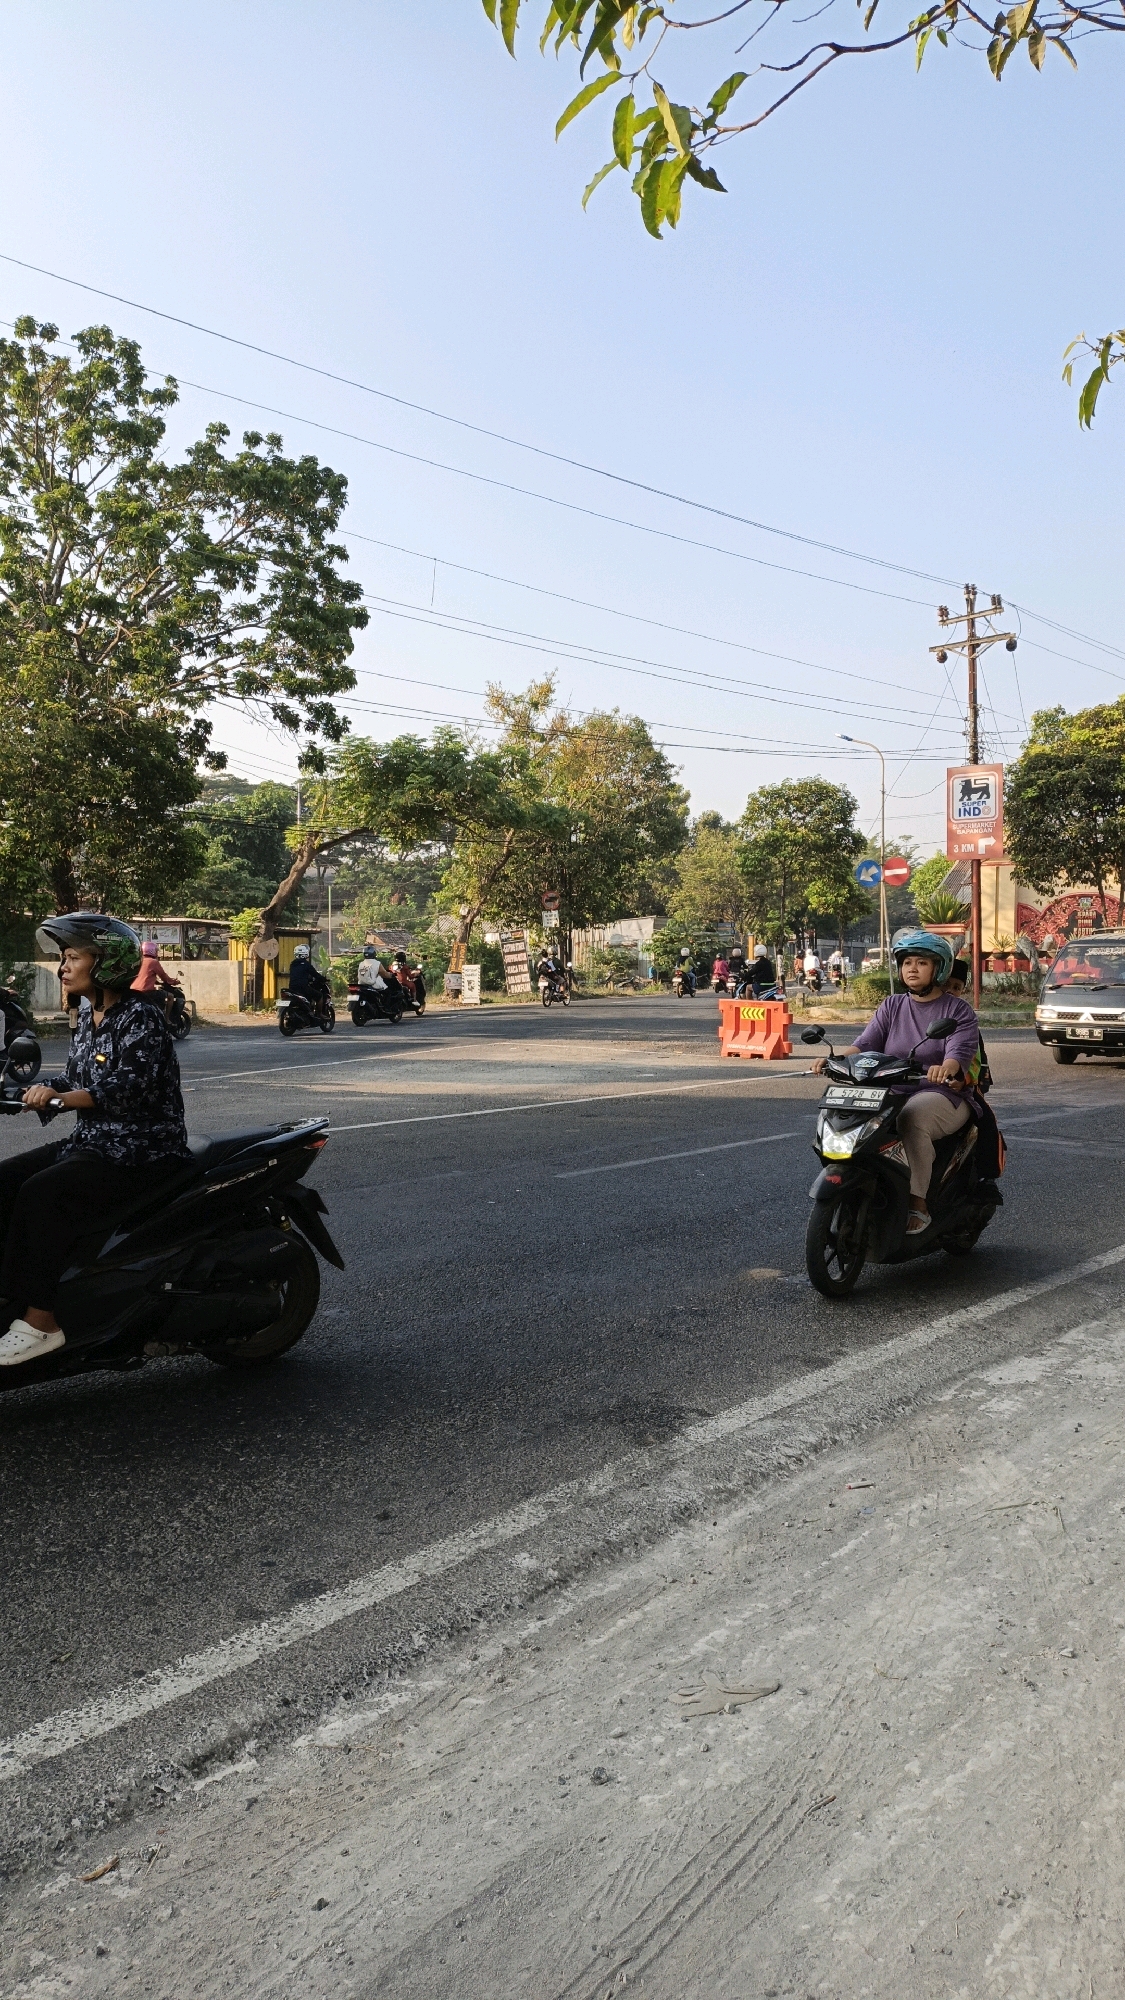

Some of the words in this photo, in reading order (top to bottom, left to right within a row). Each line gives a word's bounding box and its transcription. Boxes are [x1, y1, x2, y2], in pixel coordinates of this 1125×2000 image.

[952, 822, 996, 830] SUPERMARKET
[953, 845, 959, 853] 3
[961, 844, 975, 852] KM
[828, 1088, 836, 1096] K
